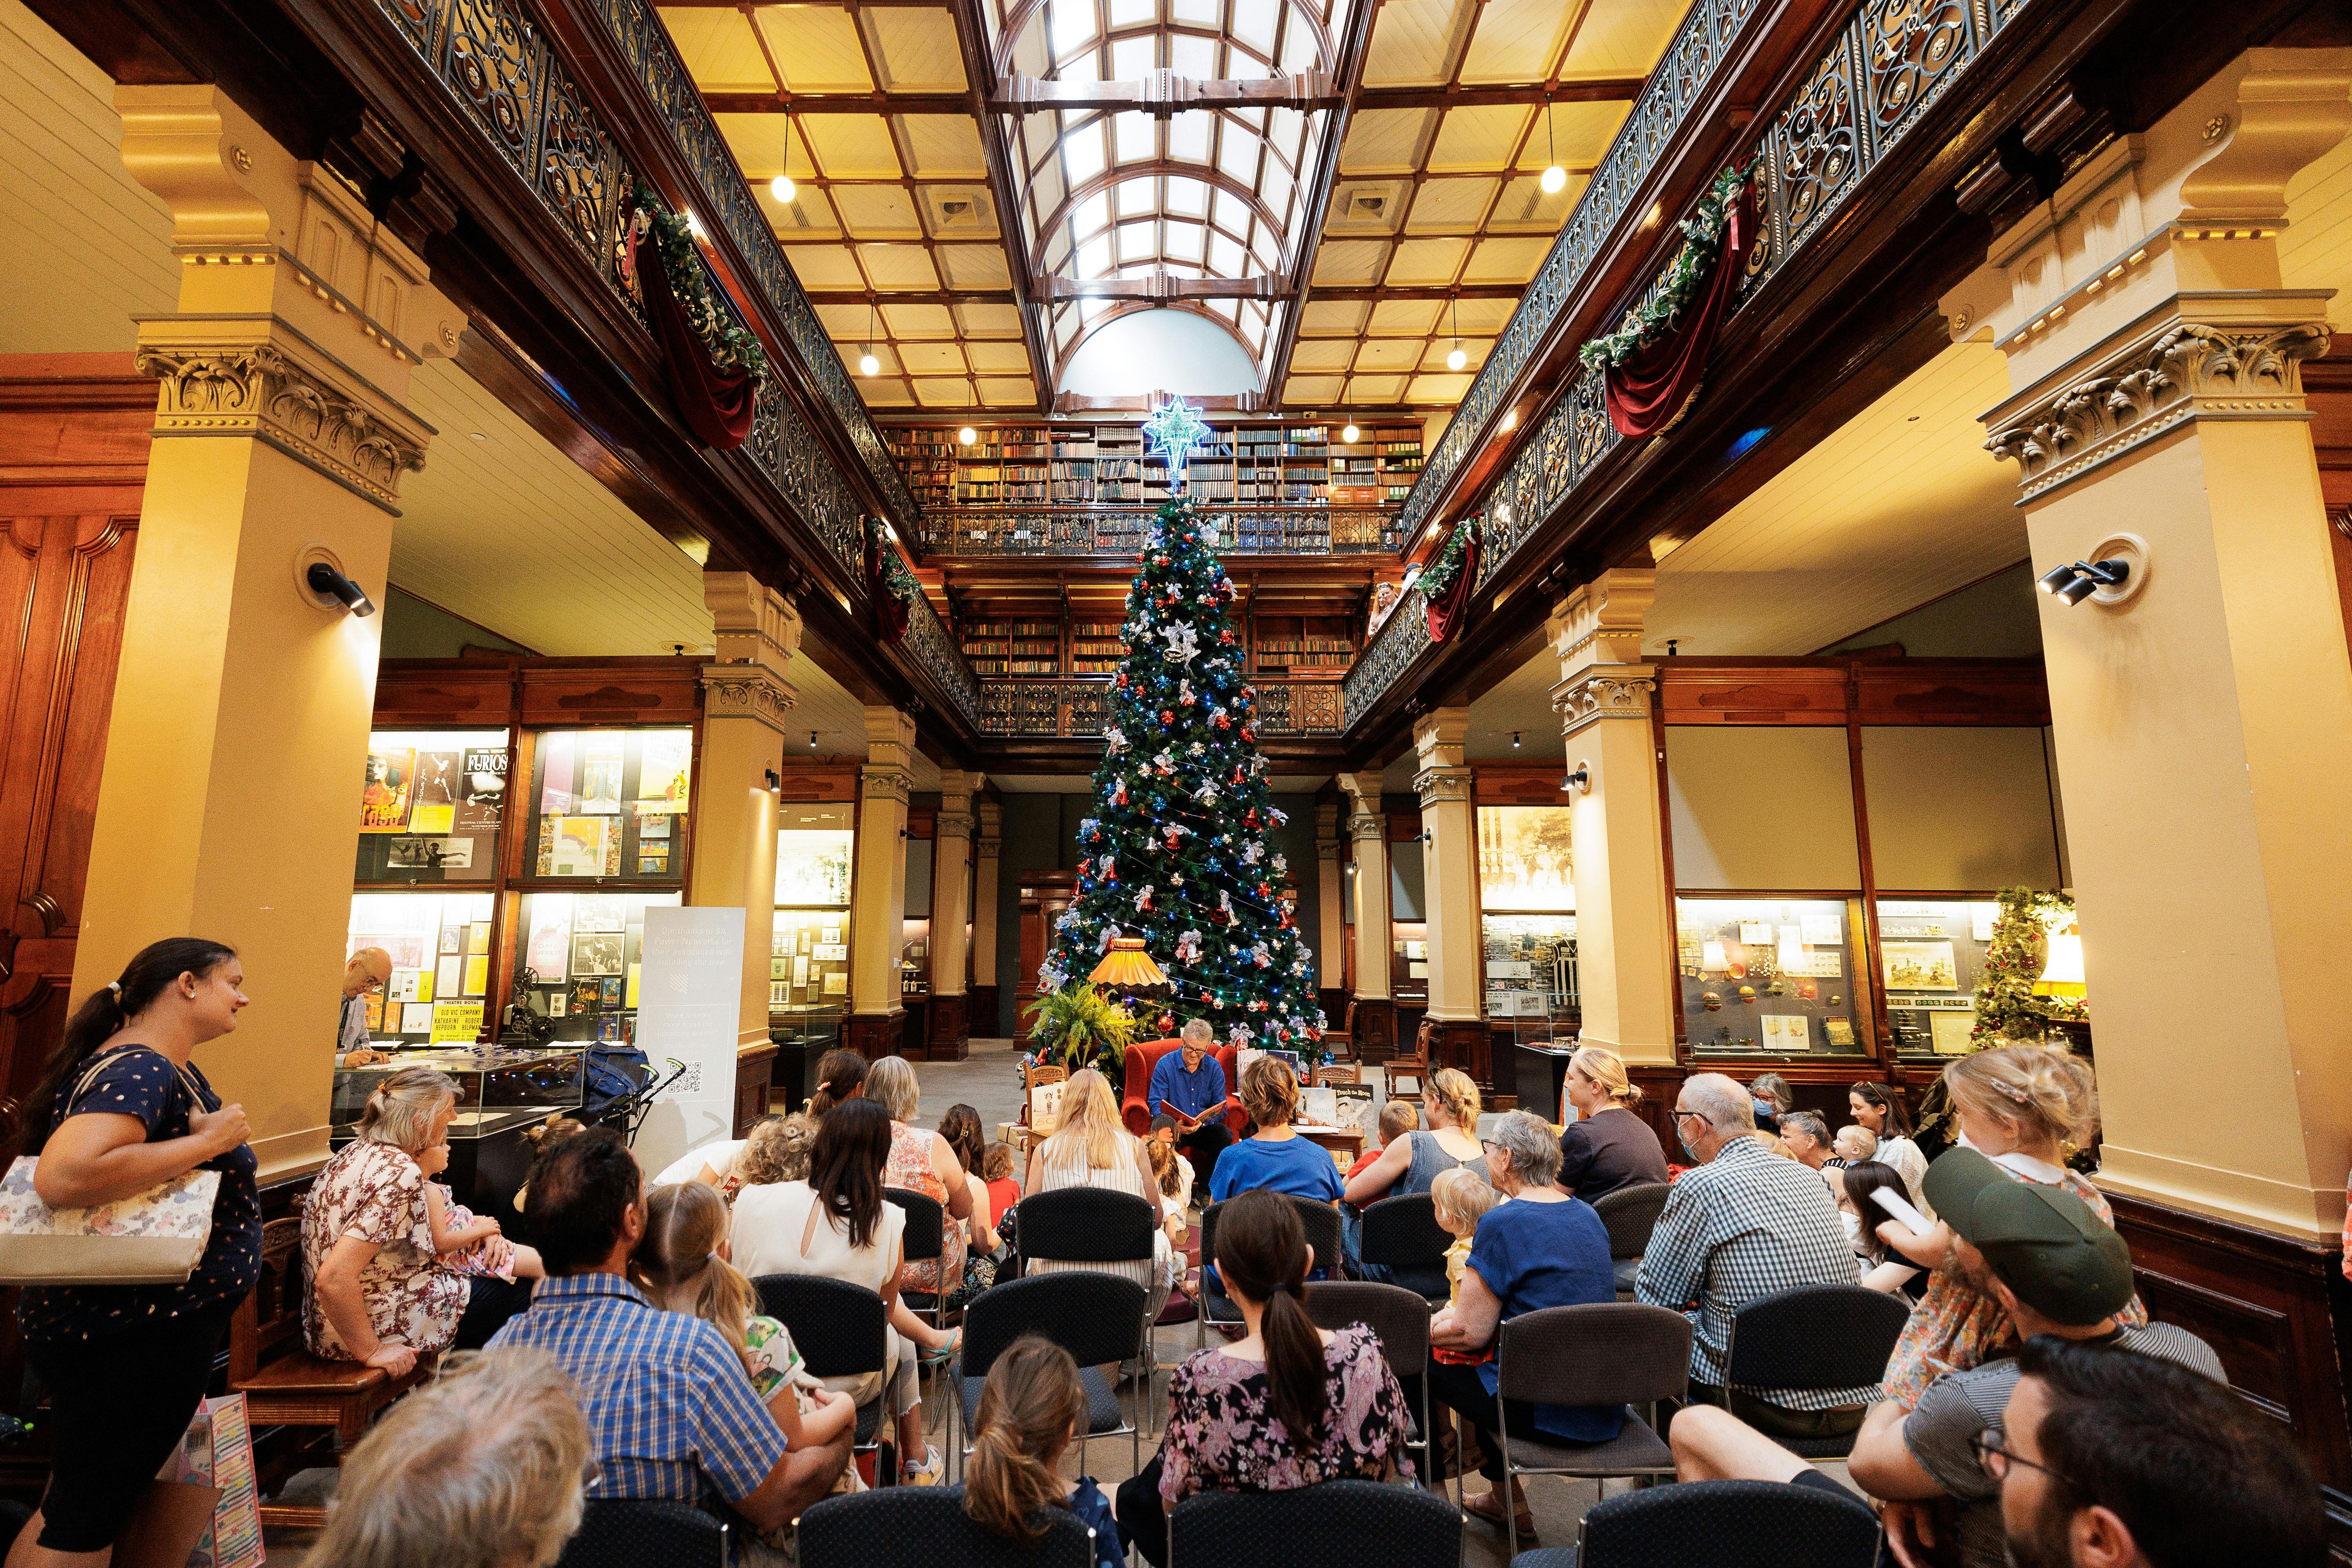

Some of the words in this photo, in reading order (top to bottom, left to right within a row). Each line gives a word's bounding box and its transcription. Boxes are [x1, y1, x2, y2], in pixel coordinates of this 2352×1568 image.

[467, 754, 508, 771] FURIOS
[531, 940, 566, 949] WOMAN
[657, 958, 692, 967] installing
[1035, 1118, 1055, 1126] BO
